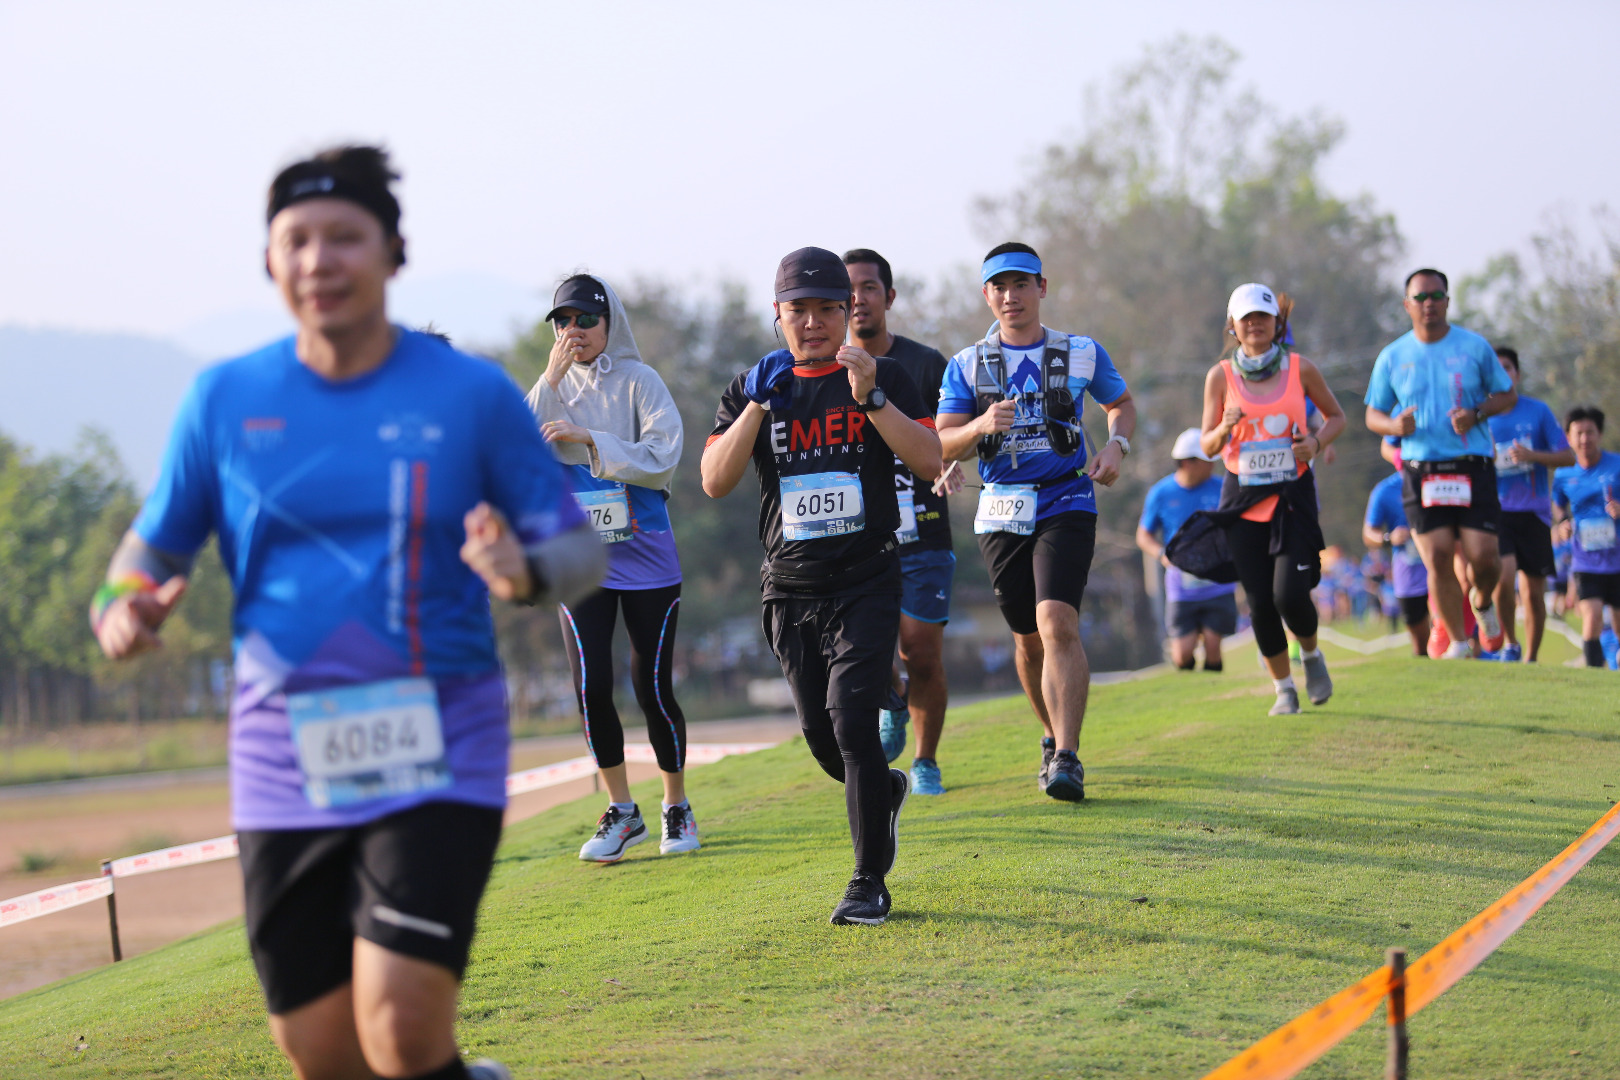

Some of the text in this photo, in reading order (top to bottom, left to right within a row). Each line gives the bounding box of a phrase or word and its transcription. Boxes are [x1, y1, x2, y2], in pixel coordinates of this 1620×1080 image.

[826, 406, 845, 415] SINCE
[771, 411, 866, 454] EMER
[774, 444, 865, 464] RUNNING
[1249, 452, 1285, 470] 6027
[796, 492, 844, 517] 6051
[988, 499, 1024, 516] 6029
[586, 508, 612, 526] 176
[846, 522, 856, 532] 16
[1019, 525, 1027, 534] 16
[616, 533, 625, 542] 16
[324, 714, 419, 765] 6084
